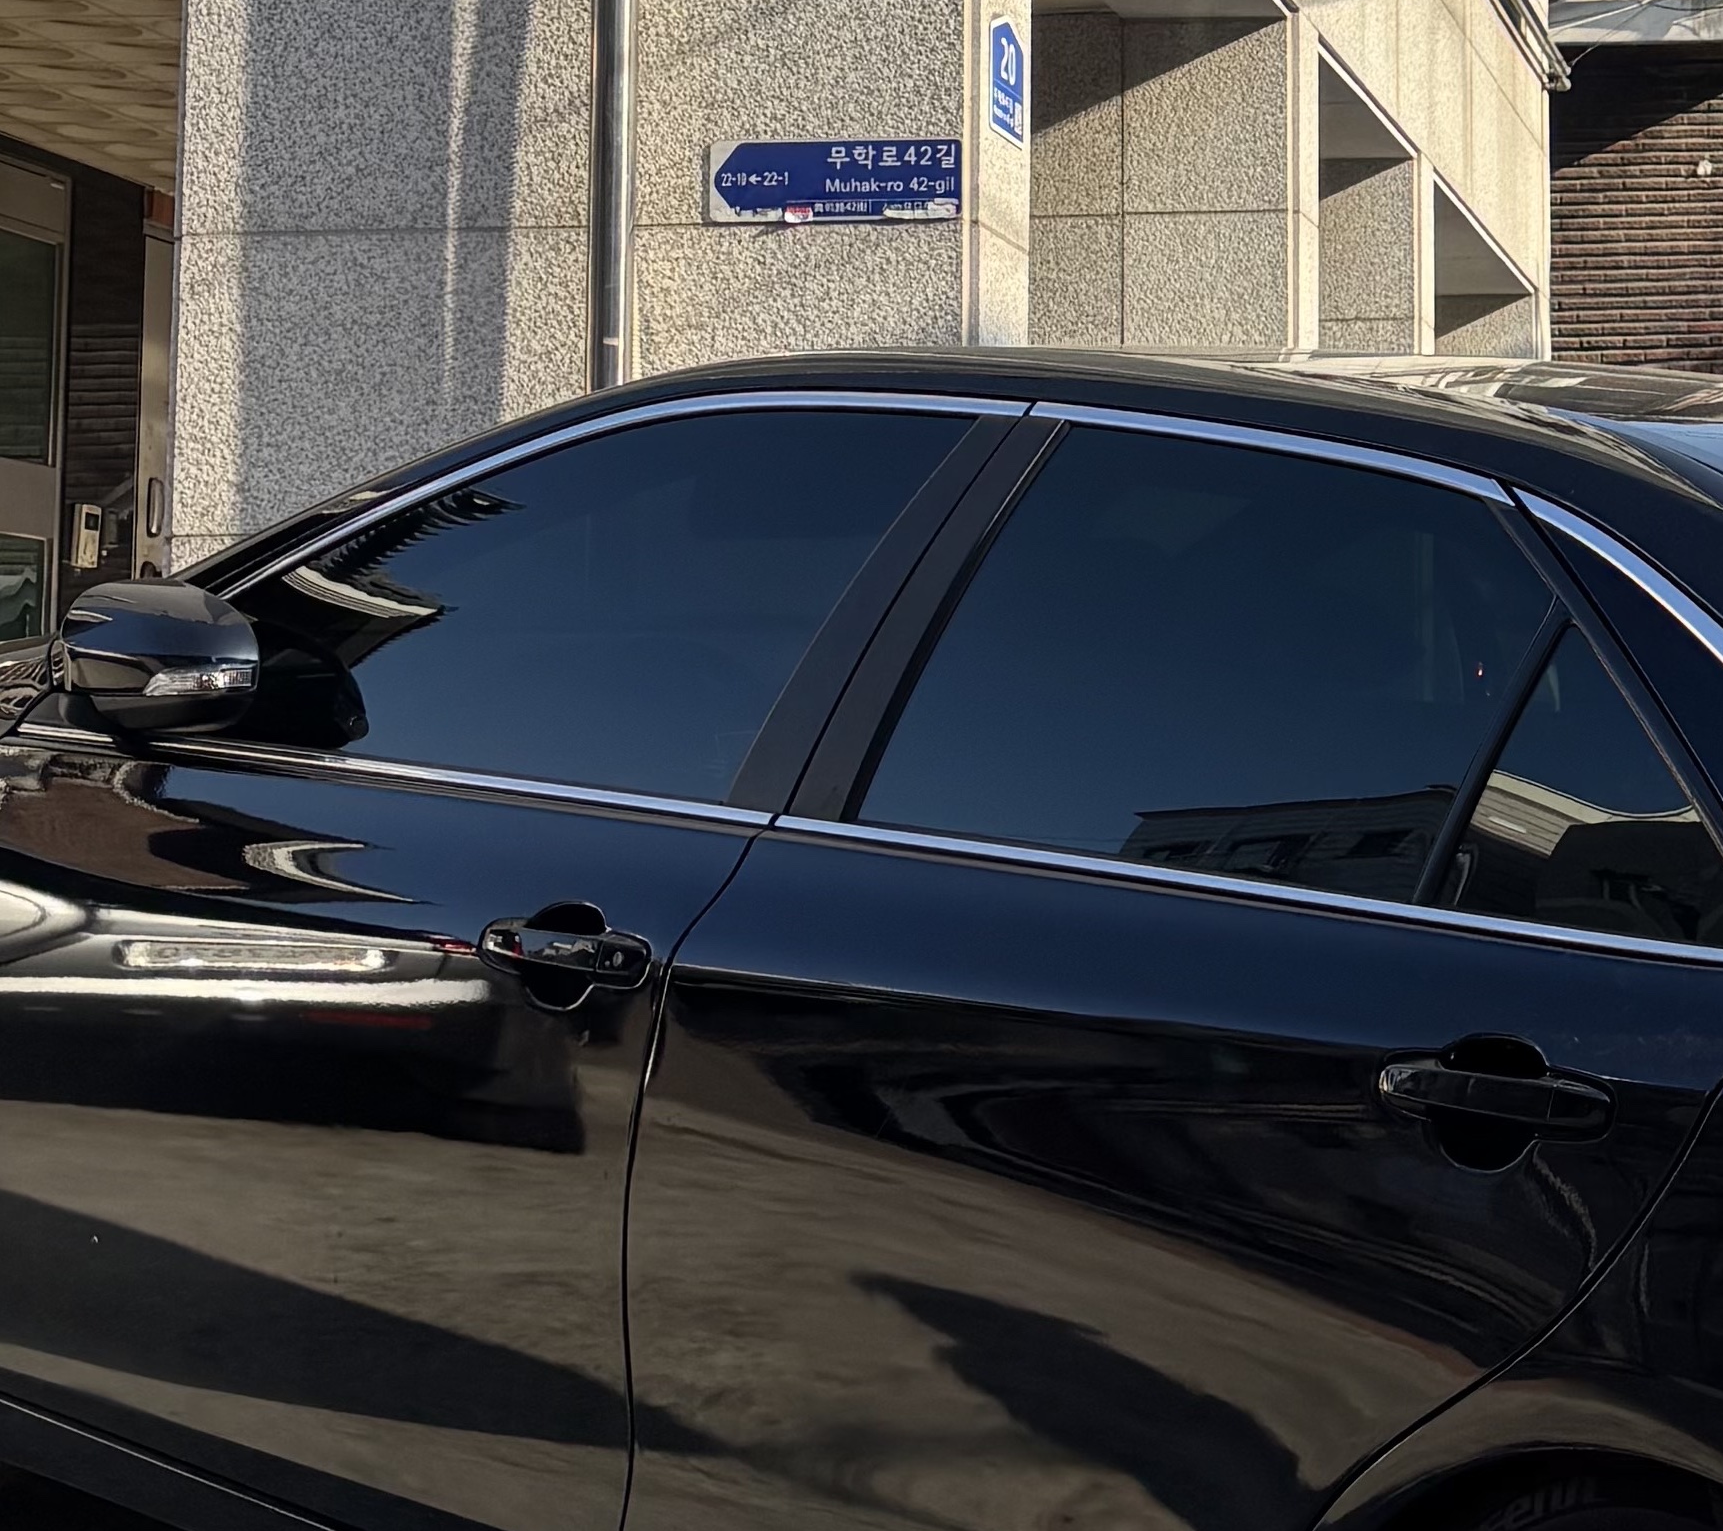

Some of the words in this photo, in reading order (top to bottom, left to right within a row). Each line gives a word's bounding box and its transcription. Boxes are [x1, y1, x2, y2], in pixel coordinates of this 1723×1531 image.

[1000, 36, 1016, 86] 20
[827, 143, 956, 170] 무학로42길
[763, 171, 789, 186] 22-1
[825, 178, 904, 193] Muhak-ro
[909, 176, 955, 194] 42-gil
